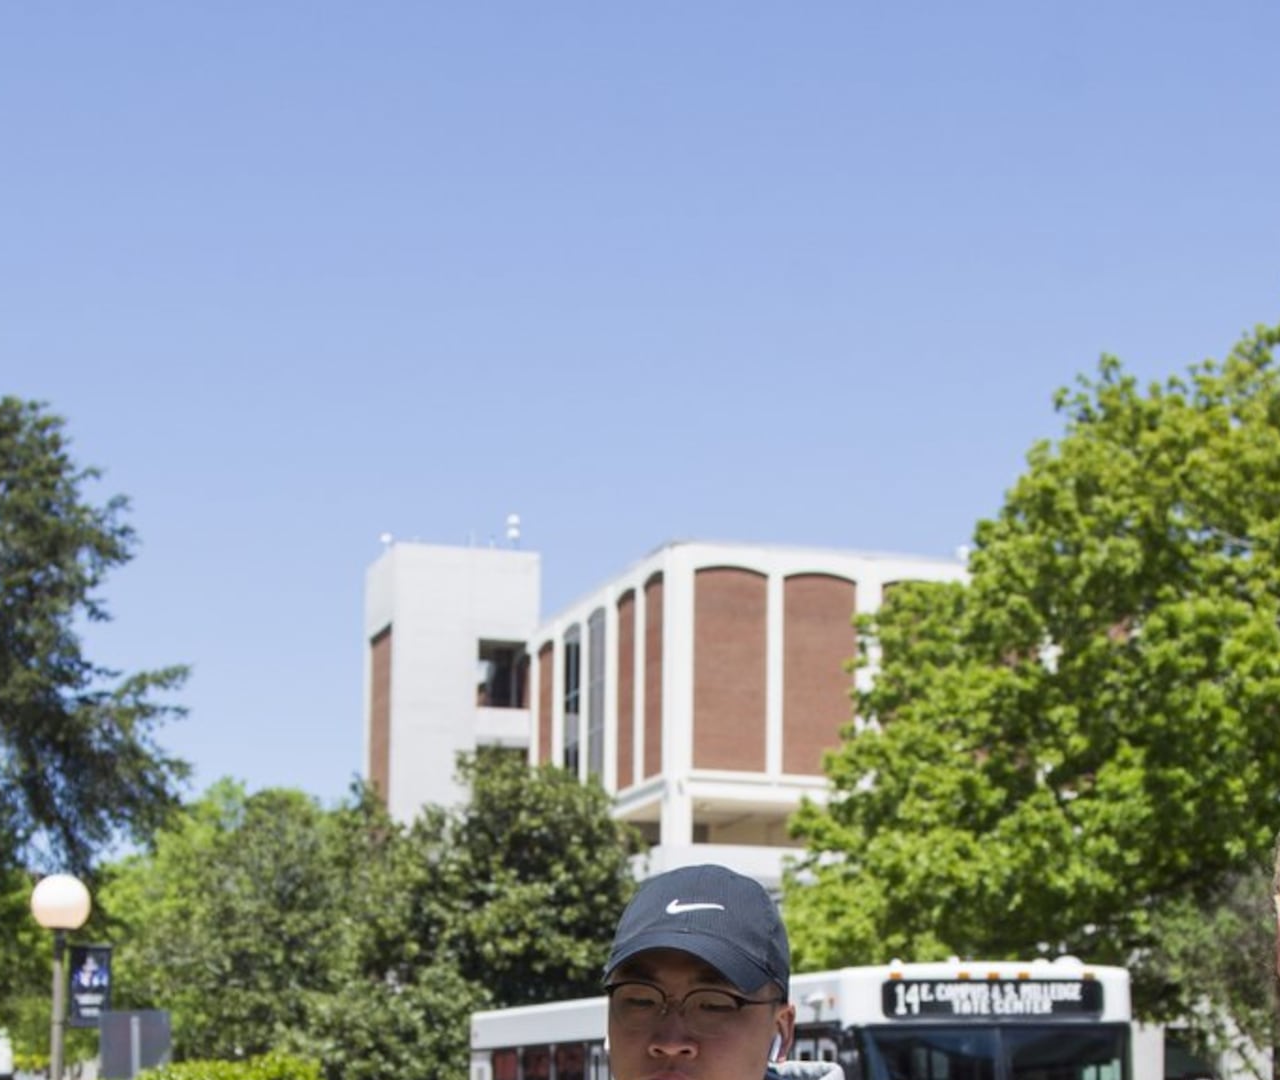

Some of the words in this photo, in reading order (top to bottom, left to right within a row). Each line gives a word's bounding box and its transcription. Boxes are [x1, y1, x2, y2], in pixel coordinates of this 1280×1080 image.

[895, 983, 920, 1015] 14
[935, 983, 990, 1001] CAMPUS
[952, 1000, 991, 1014] TATE
[993, 1000, 1053, 1014] CENTER
